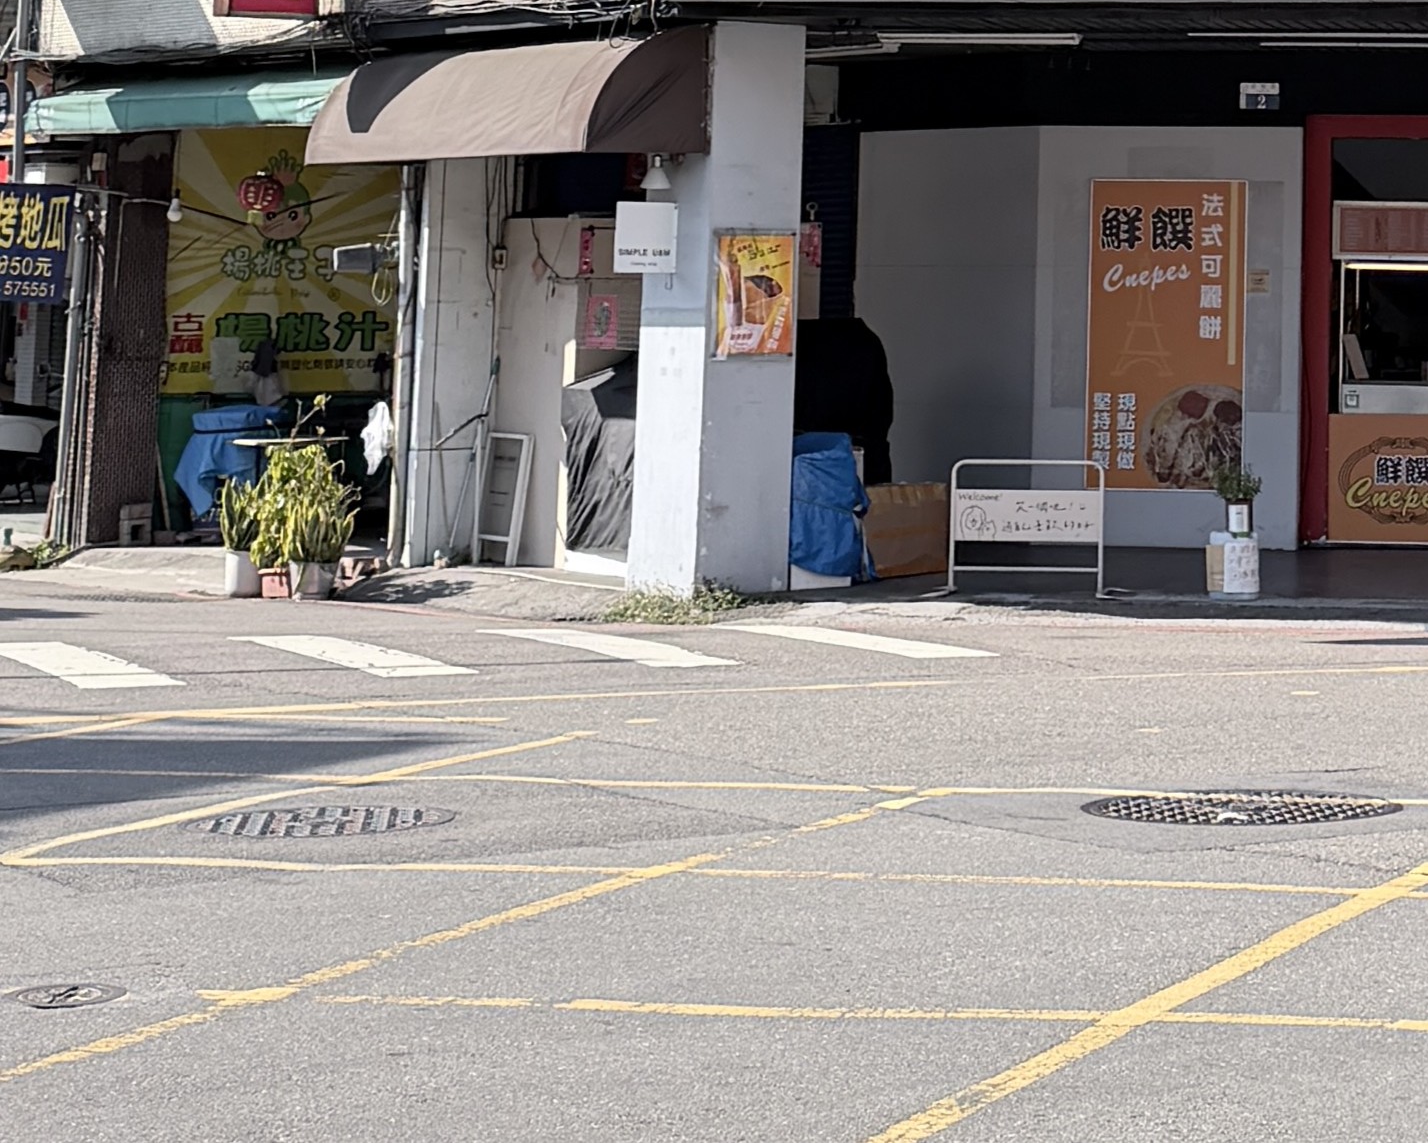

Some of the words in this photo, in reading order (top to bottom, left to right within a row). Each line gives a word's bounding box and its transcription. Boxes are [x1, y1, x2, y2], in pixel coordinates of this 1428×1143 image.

[1256, 94, 1267, 110] 2
[1100, 204, 1196, 252] 鮮饌
[216, 311, 389, 352] 楊桃汁
